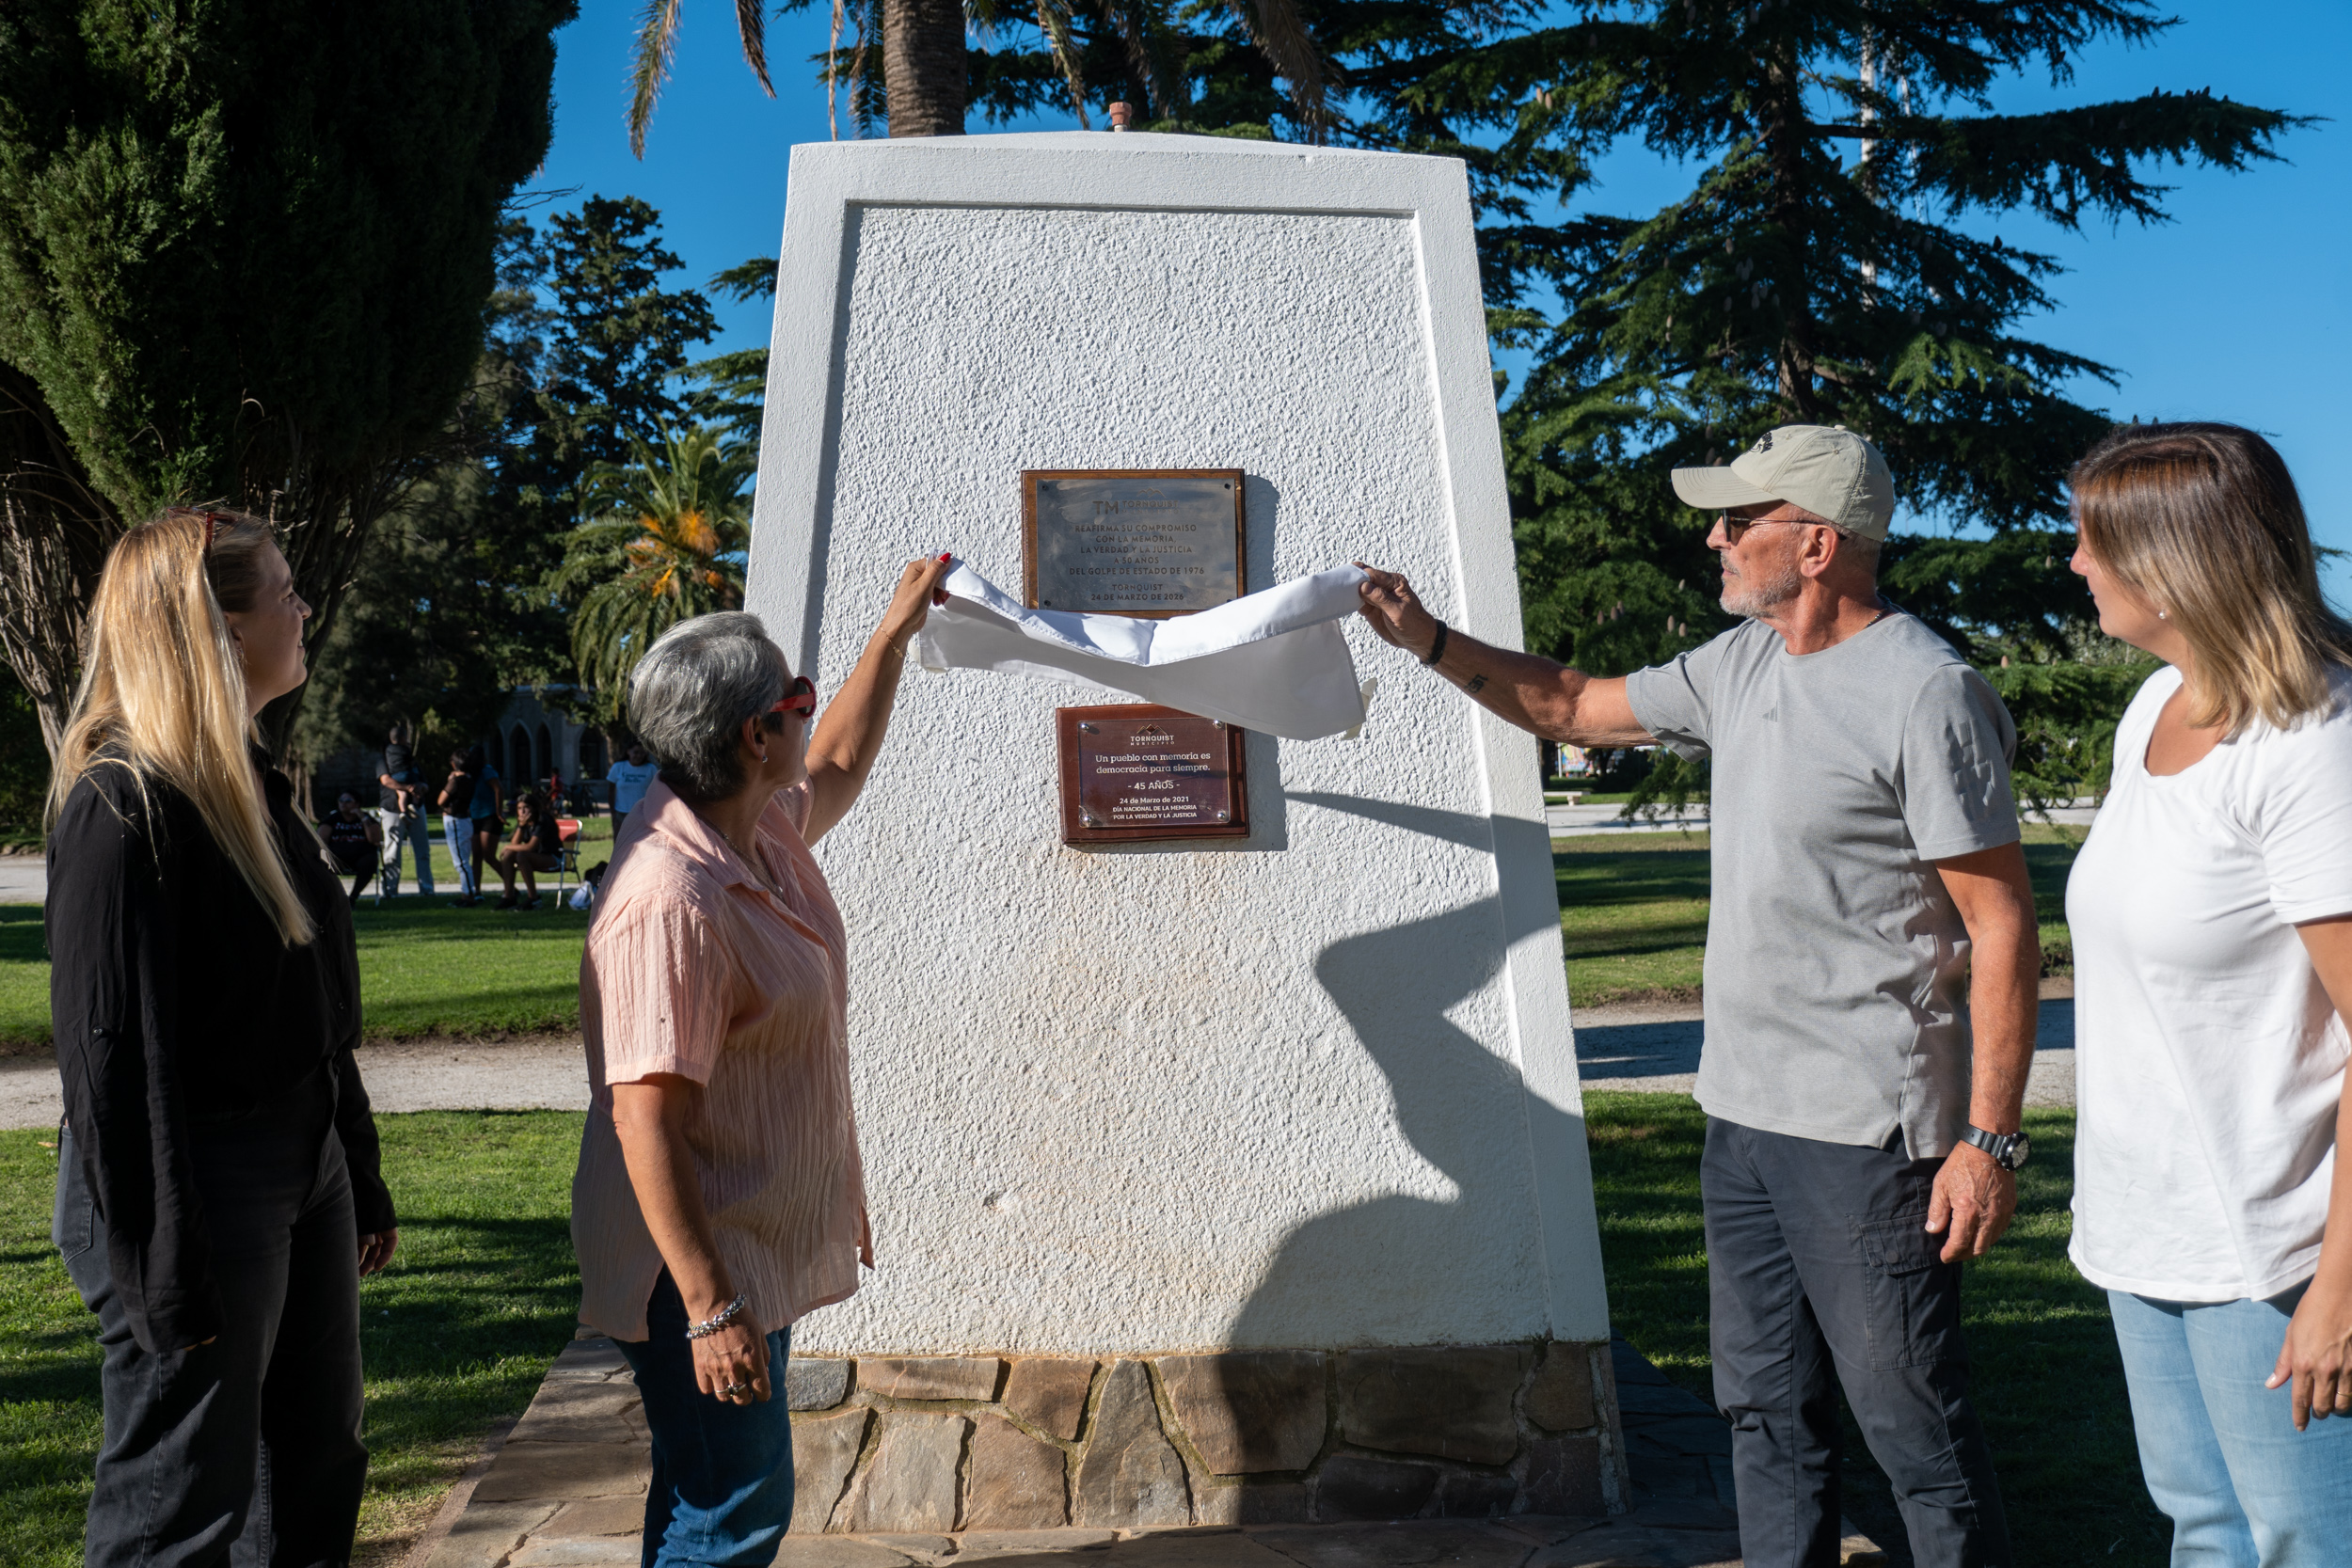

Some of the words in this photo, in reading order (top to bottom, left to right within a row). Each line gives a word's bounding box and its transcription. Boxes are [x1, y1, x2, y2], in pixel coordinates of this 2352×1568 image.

[1092, 500, 1119, 515] TM
[1121, 524, 1133, 532] SU
[1132, 535, 1177, 544] MEMORIA,
[1110, 753, 1140, 764] pueblo
[1160, 752, 1199, 761] memoria
[1096, 765, 1148, 774] democracia
[1150, 765, 1171, 773] para
[1173, 764, 1211, 773] siempre.
[1134, 782, 1146, 790] 45
[1148, 780, 1174, 789] AÑOS
